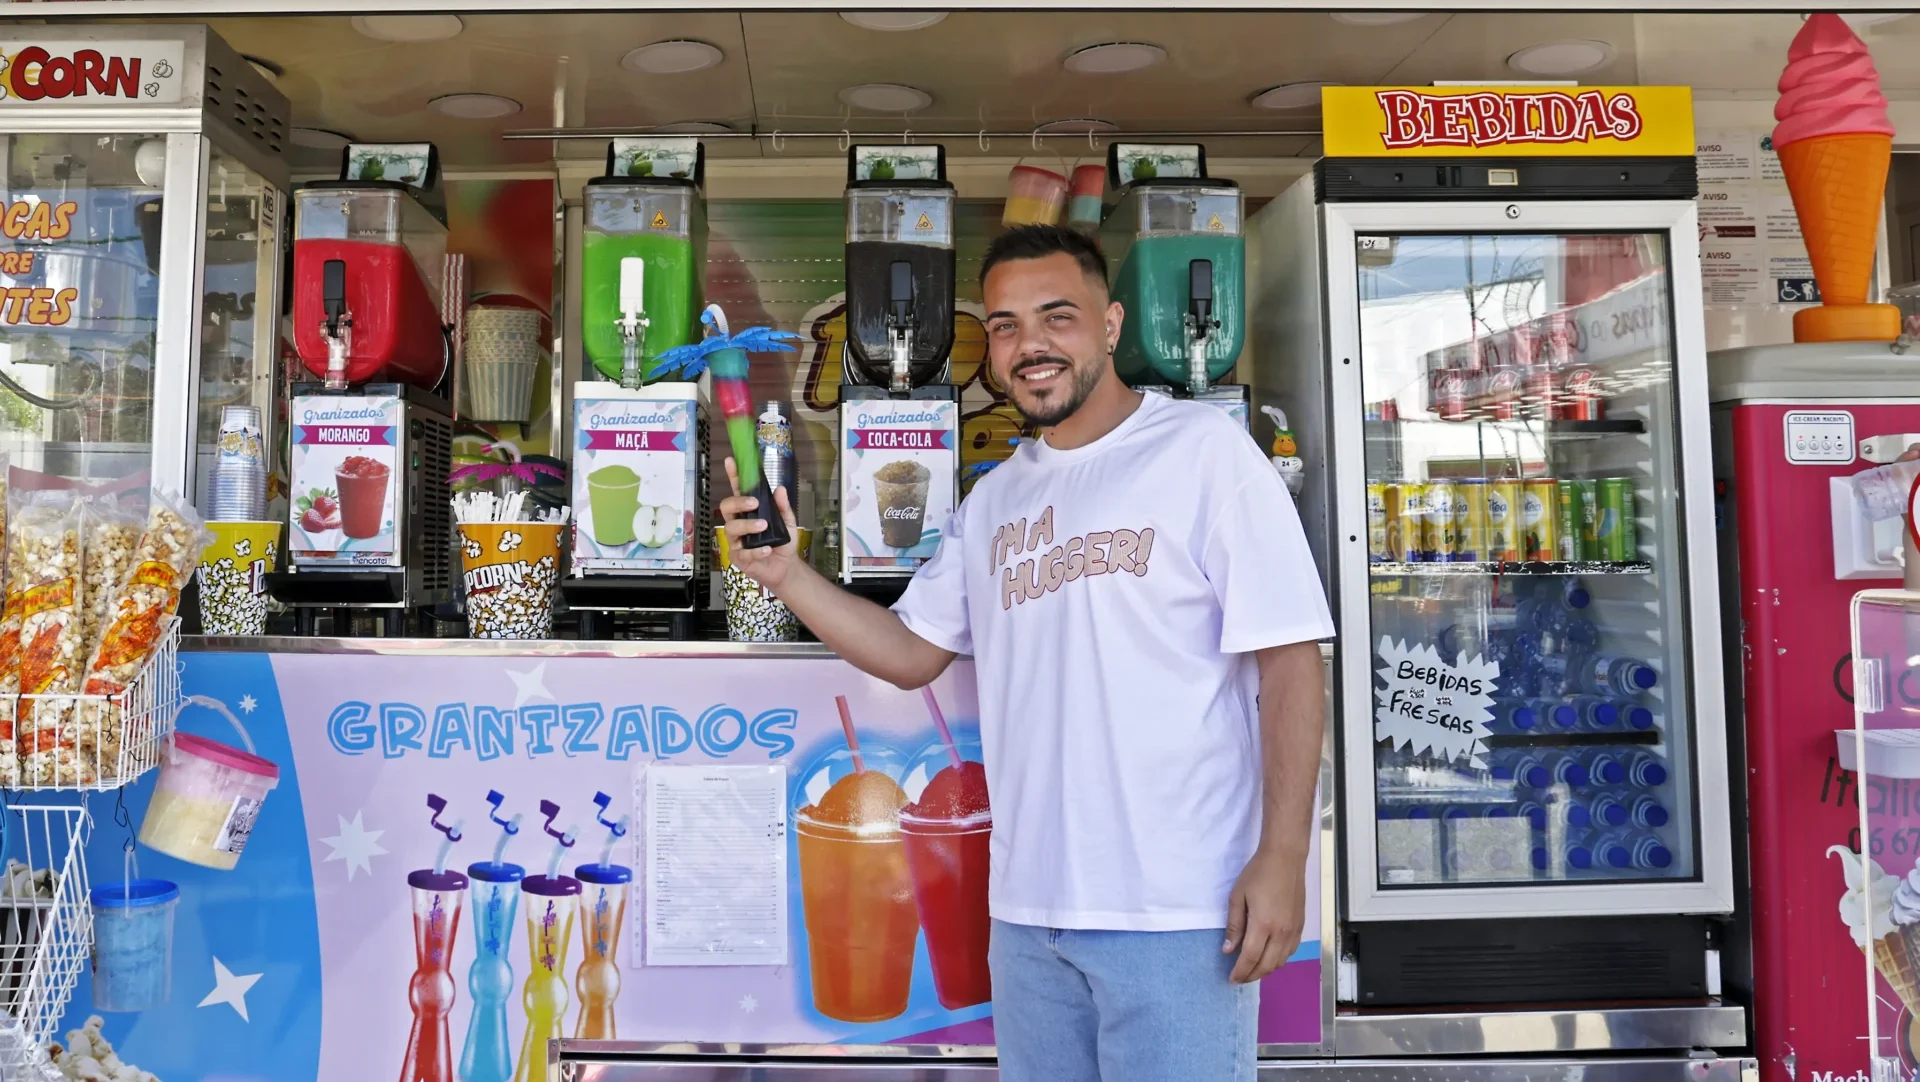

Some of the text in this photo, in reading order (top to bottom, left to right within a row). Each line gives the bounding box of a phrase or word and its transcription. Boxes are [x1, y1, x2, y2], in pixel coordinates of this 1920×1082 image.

[10, 46, 141, 100] CORN
[1376, 90, 1642, 149] BEBIDAS
[0, 201, 77, 239] CAS
[303, 407, 385, 425] Granizados
[590, 413, 674, 430] Granizados
[857, 411, 942, 429] Granizados
[318, 428, 370, 443] MORANGO
[615, 432, 649, 450] MAÇÃ
[868, 432, 932, 447] COCA-COLA
[990, 505, 1053, 576] I'M A
[1002, 528, 1155, 610] HUGGER!
[327, 701, 798, 761] GRANIZADOS
[1390, 690, 1473, 734] FRESCAS
